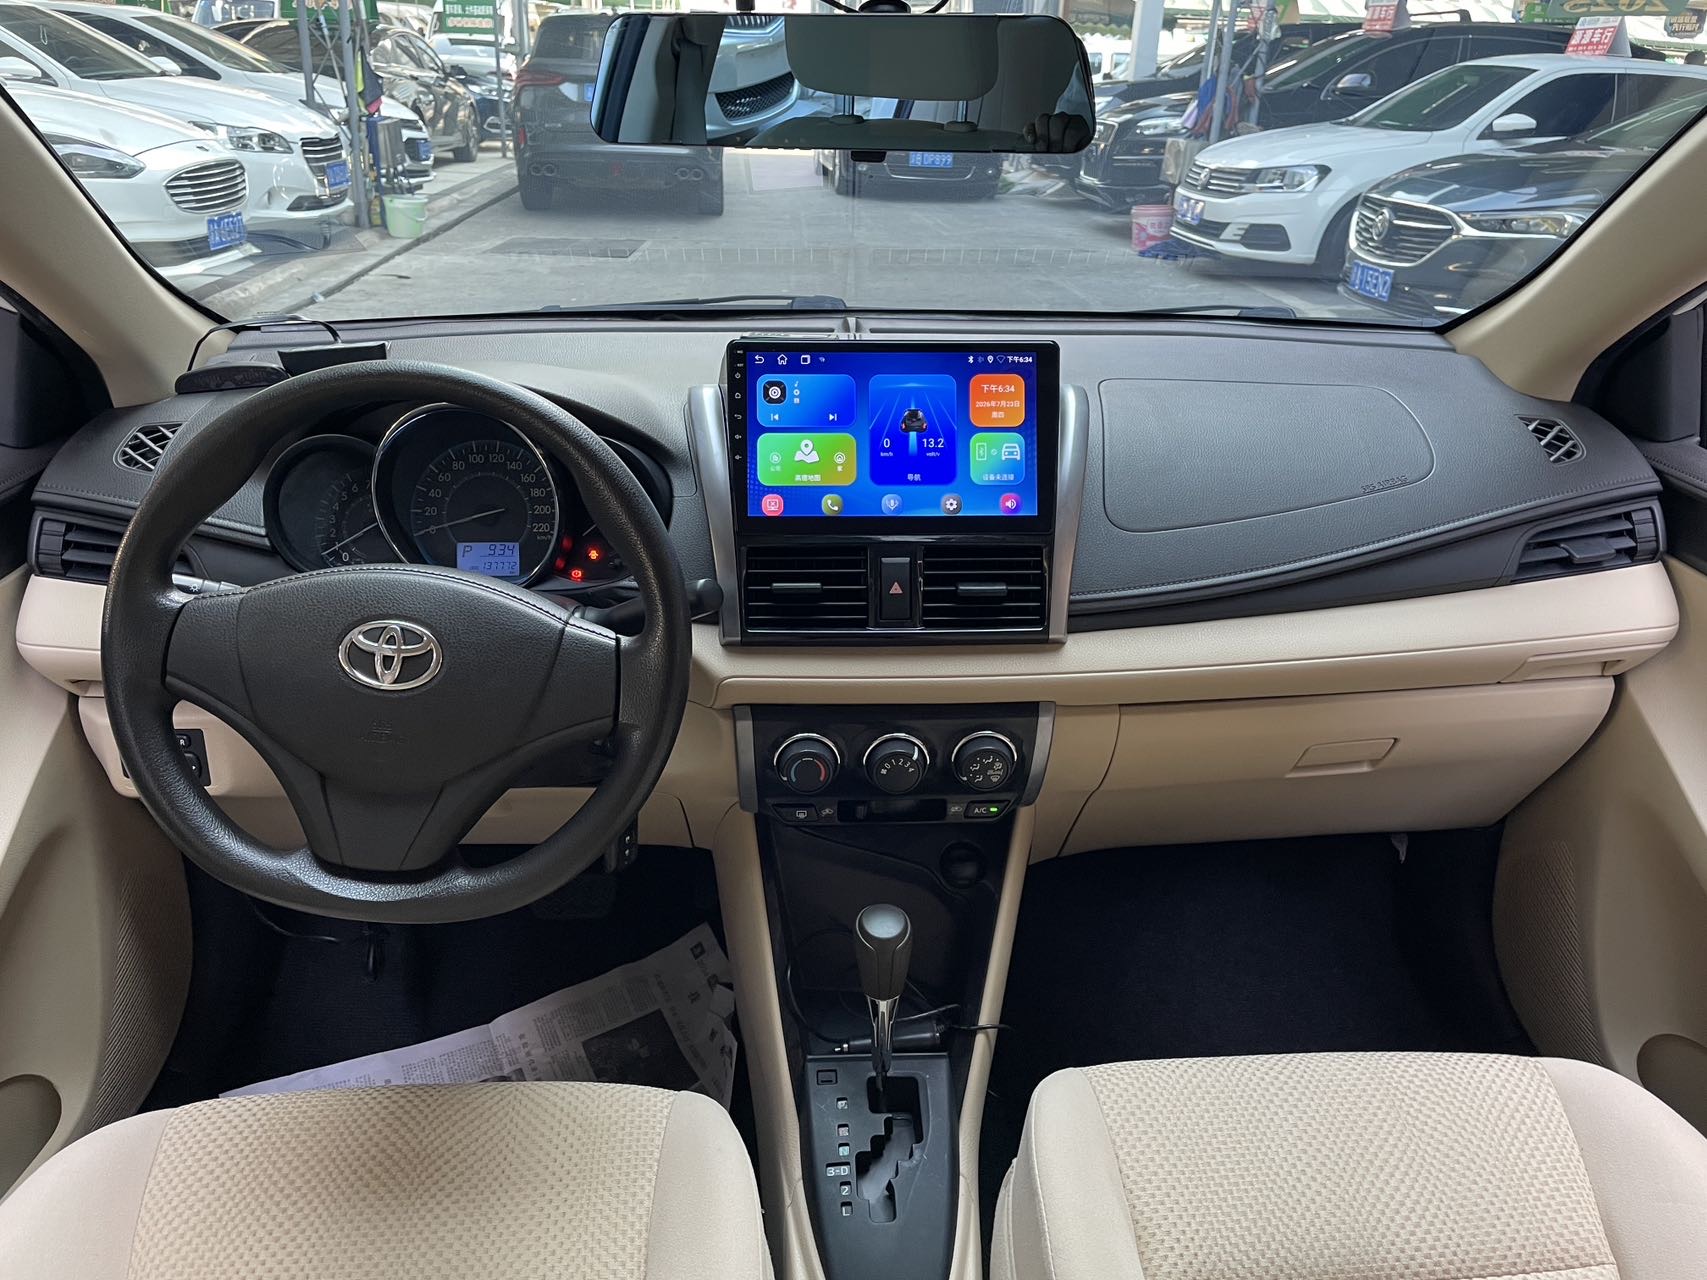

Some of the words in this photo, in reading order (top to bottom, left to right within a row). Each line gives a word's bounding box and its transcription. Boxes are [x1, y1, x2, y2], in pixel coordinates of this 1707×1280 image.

[1007, 355, 1033, 363] 下午6:34
[981, 384, 1016, 394] 下午6:34
[883, 437, 891, 449] 0
[922, 437, 945, 449] 13.2
[468, 454, 484, 464] 100
[489, 453, 505, 463] 120
[452, 461, 465, 471] 80
[507, 461, 523, 470] 140
[438, 472, 451, 482] 60
[520, 473, 536, 483] 160
[428, 488, 442, 498] 40
[529, 488, 546, 497] 180
[424, 506, 438, 516] 20
[533, 505, 551, 515] 200
[532, 523, 550, 533] 220
[462, 544, 473, 558] P
[488, 543, 515, 556] 934
[342, 552, 350, 562] 0
[483, 561, 517, 570] 137772
[898, 758, 904, 766] 2
[827, 1166, 849, 1177] 3-D
[840, 1186, 849, 1196] 2
[842, 1206, 851, 1216] L
